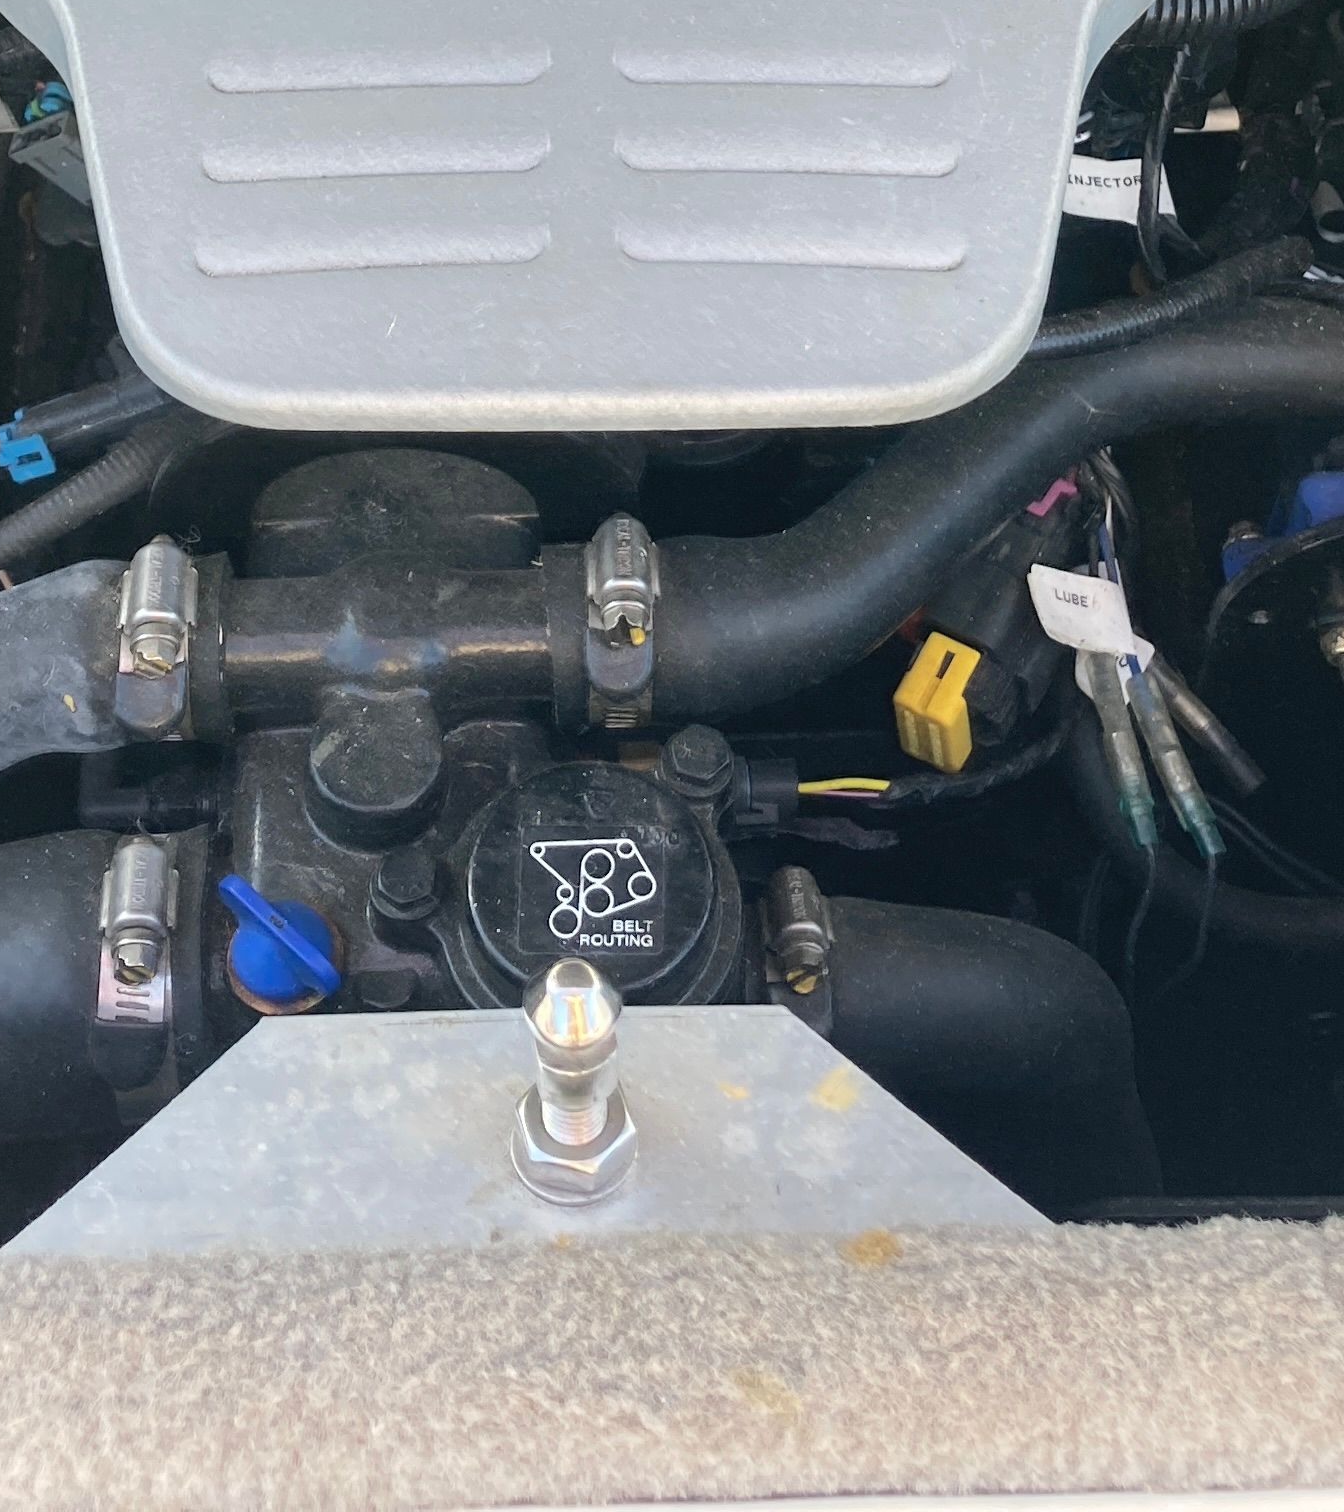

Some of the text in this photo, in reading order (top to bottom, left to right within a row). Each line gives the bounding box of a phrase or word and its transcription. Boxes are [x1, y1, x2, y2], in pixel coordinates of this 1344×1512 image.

[1055, 588, 1089, 608] LUBE
[613, 920, 654, 933] BELT
[580, 934, 654, 948] ROUTING
